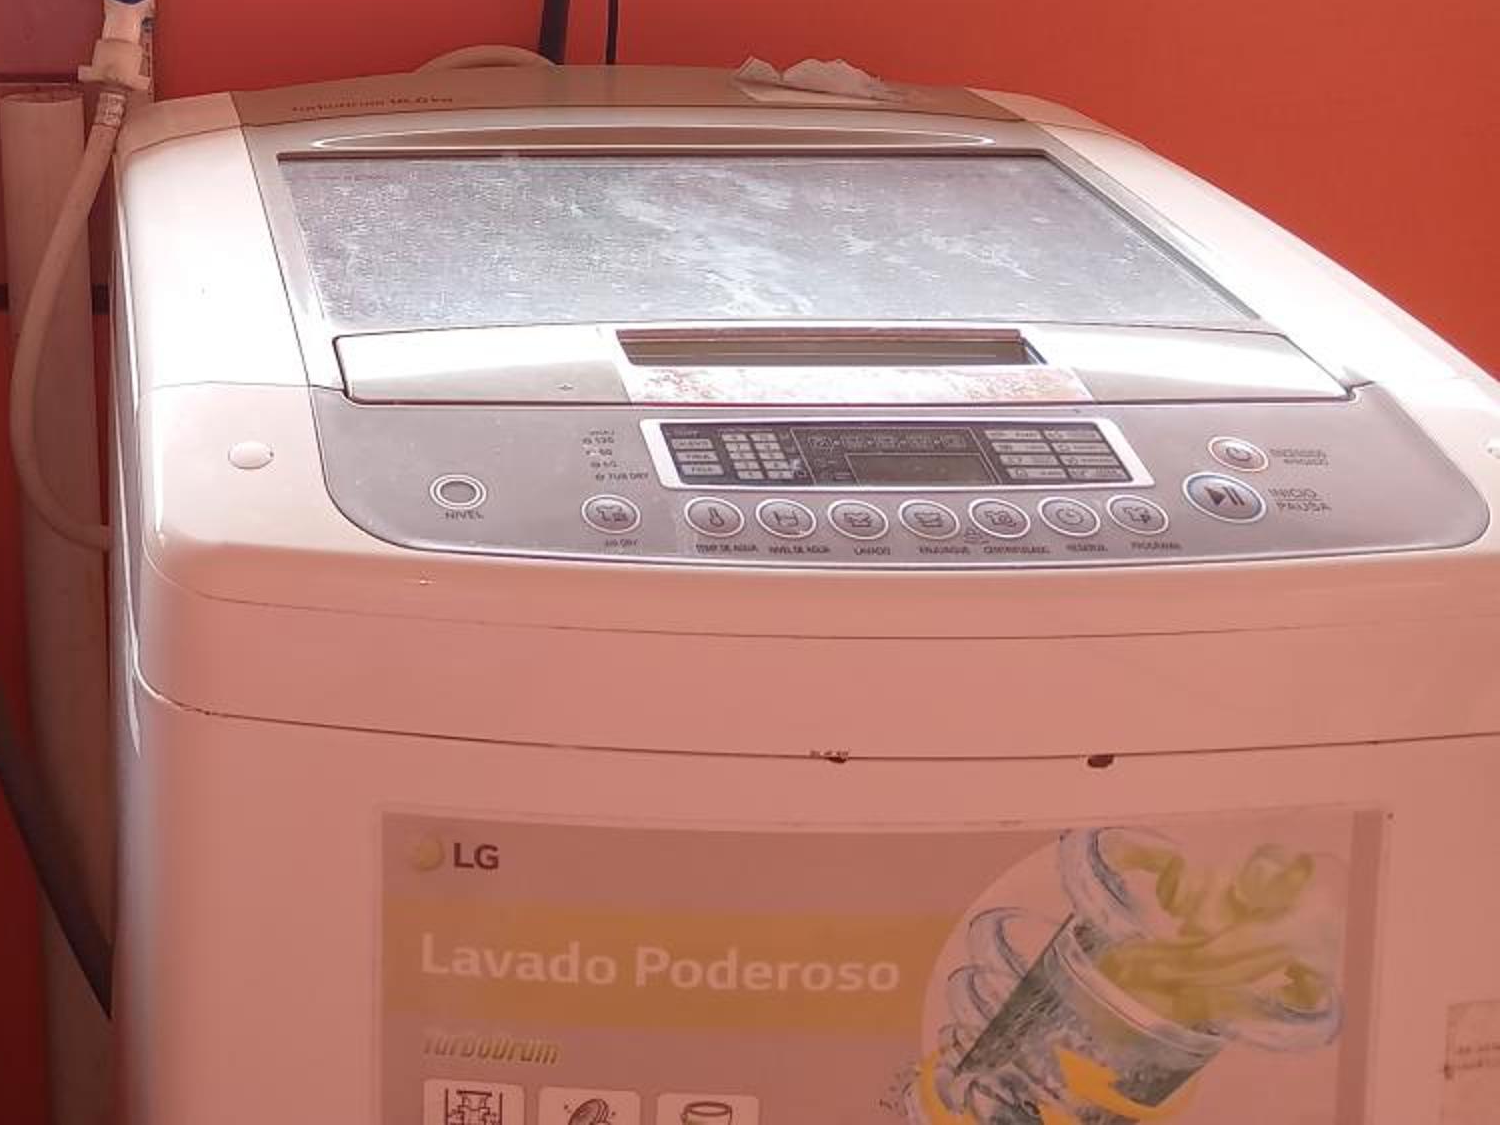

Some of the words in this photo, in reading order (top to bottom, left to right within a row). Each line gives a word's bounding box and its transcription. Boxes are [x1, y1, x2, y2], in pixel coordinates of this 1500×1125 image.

[445, 510, 484, 520] NIVEL
[1275, 501, 1332, 512] PAUSA
[453, 842, 499, 870] LG
[420, 932, 618, 985] Lavado
[635, 945, 900, 992] Poderoso
